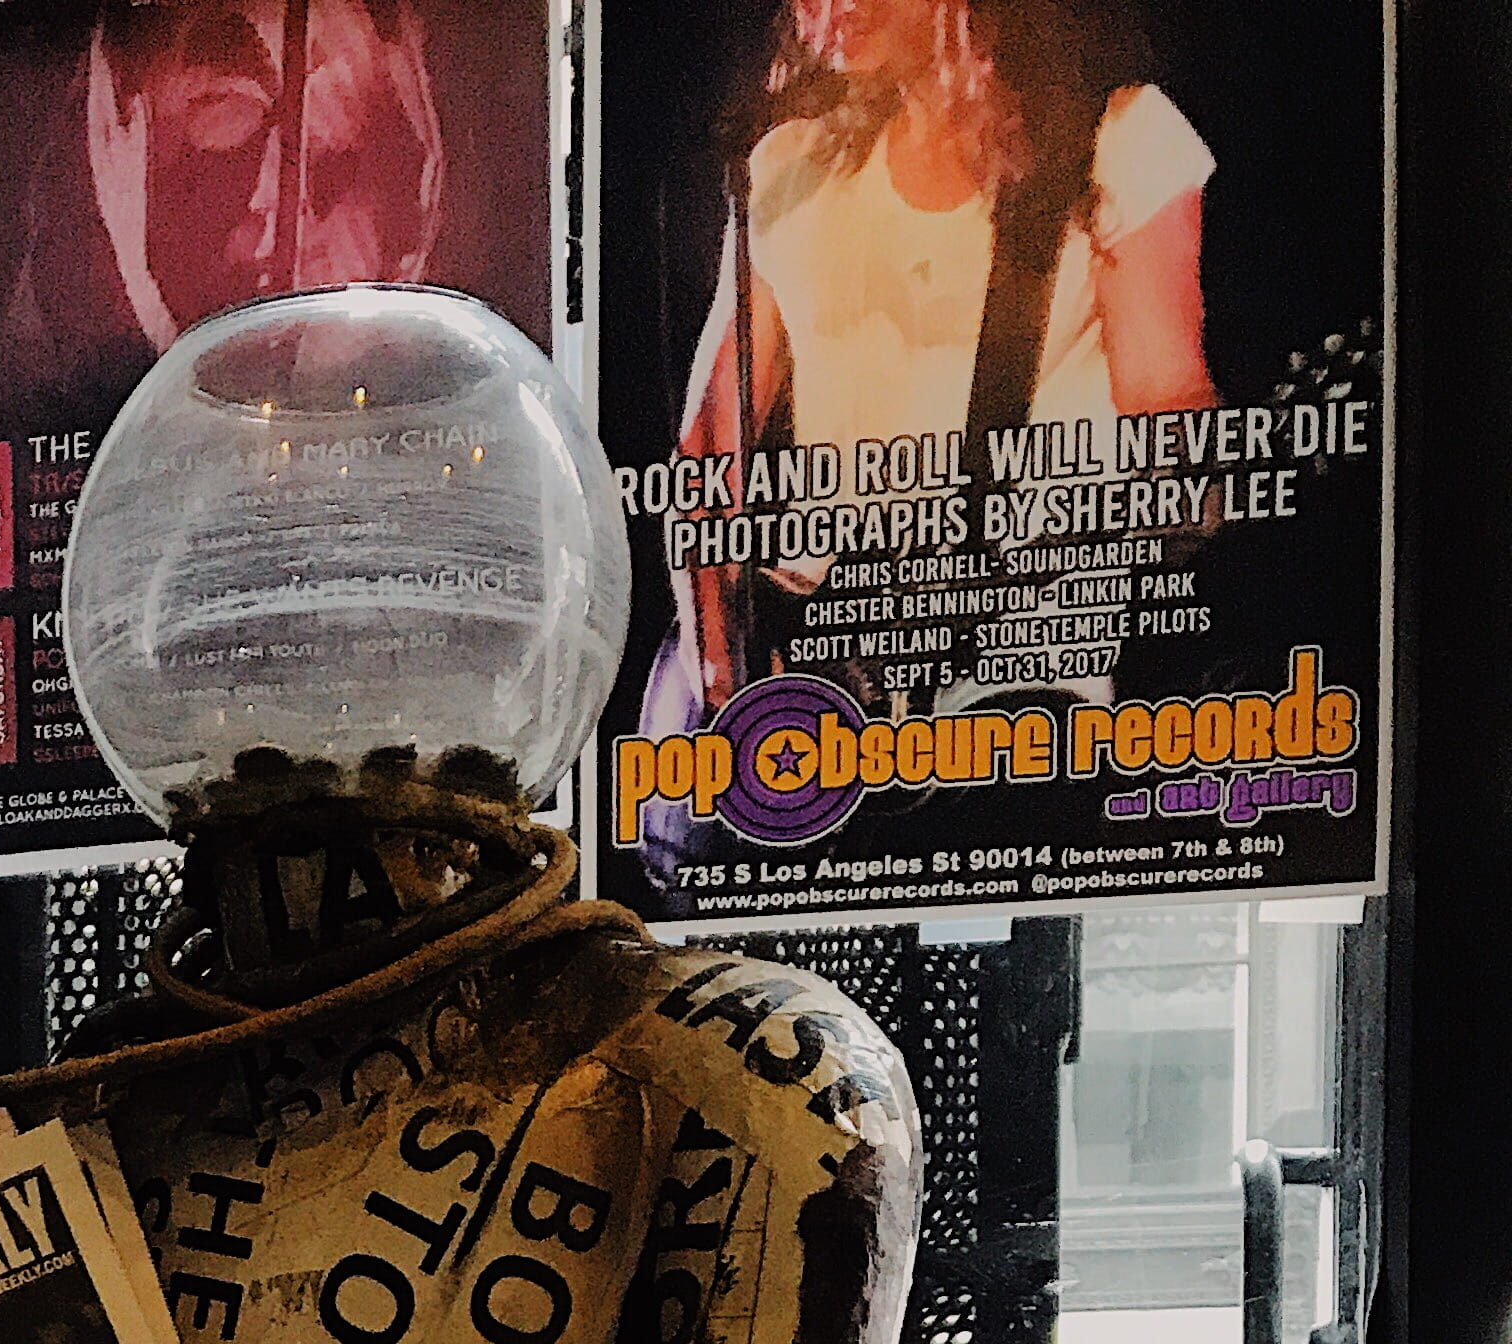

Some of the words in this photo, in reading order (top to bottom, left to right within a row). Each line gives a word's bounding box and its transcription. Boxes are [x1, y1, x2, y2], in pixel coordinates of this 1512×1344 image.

[27, 430, 92, 465] THE
[302, 432, 393, 464] MARY
[615, 453, 735, 517] ROCK
[746, 442, 841, 504] AND
[855, 431, 972, 495] ROLL
[987, 419, 1103, 482] WILL
[1117, 407, 1274, 472] NEVER
[1292, 400, 1370, 458] DIE
[29, 501, 60, 520] THE
[673, 496, 968, 569] PHOTOGRAPHS
[983, 488, 1039, 541] BY
[1044, 475, 1209, 536] SHERRY
[1224, 469, 1298, 520] LEE
[829, 561, 890, 590] CHRIS
[1006, 538, 1163, 576] SOUNDGARDEN
[805, 593, 895, 627] CHESTER
[902, 584, 1037, 620] BENNINGTON
[1060, 577, 1132, 607] LINKIN
[1140, 571, 1196, 601] PARK
[789, 634, 853, 663] SCOTT
[858, 626, 953, 656] WEILAND
[975, 618, 1042, 649] STONE
[1047, 611, 1131, 642] TEMPLE
[1138, 606, 1212, 636] PILOTS
[884, 663, 933, 689] SEPT
[940, 660, 953, 685] 5
[1060, 648, 1116, 679] 2017
[33, 722, 85, 740] TESSA
[618, 734, 733, 843] pop
[1073, 650, 1354, 773] records
[8, 790, 55, 809] GLOBE
[72, 785, 127, 802] PALACE
[677, 865, 726, 888] 735
[733, 862, 752, 884] S
[760, 861, 807, 882] Los
[815, 853, 923, 883] Angeles
[931, 850, 960, 872] St
[969, 844, 1053, 871] 90014
[1061, 843, 1164, 871] (between
[1171, 840, 1207, 861] 7th
[1215, 837, 1233, 857] &
[1239, 833, 1285, 859] 8th)
[696, 878, 1019, 911] www.popobscurerecords.com
[1031, 861, 1264, 896] @popobscurerecords
